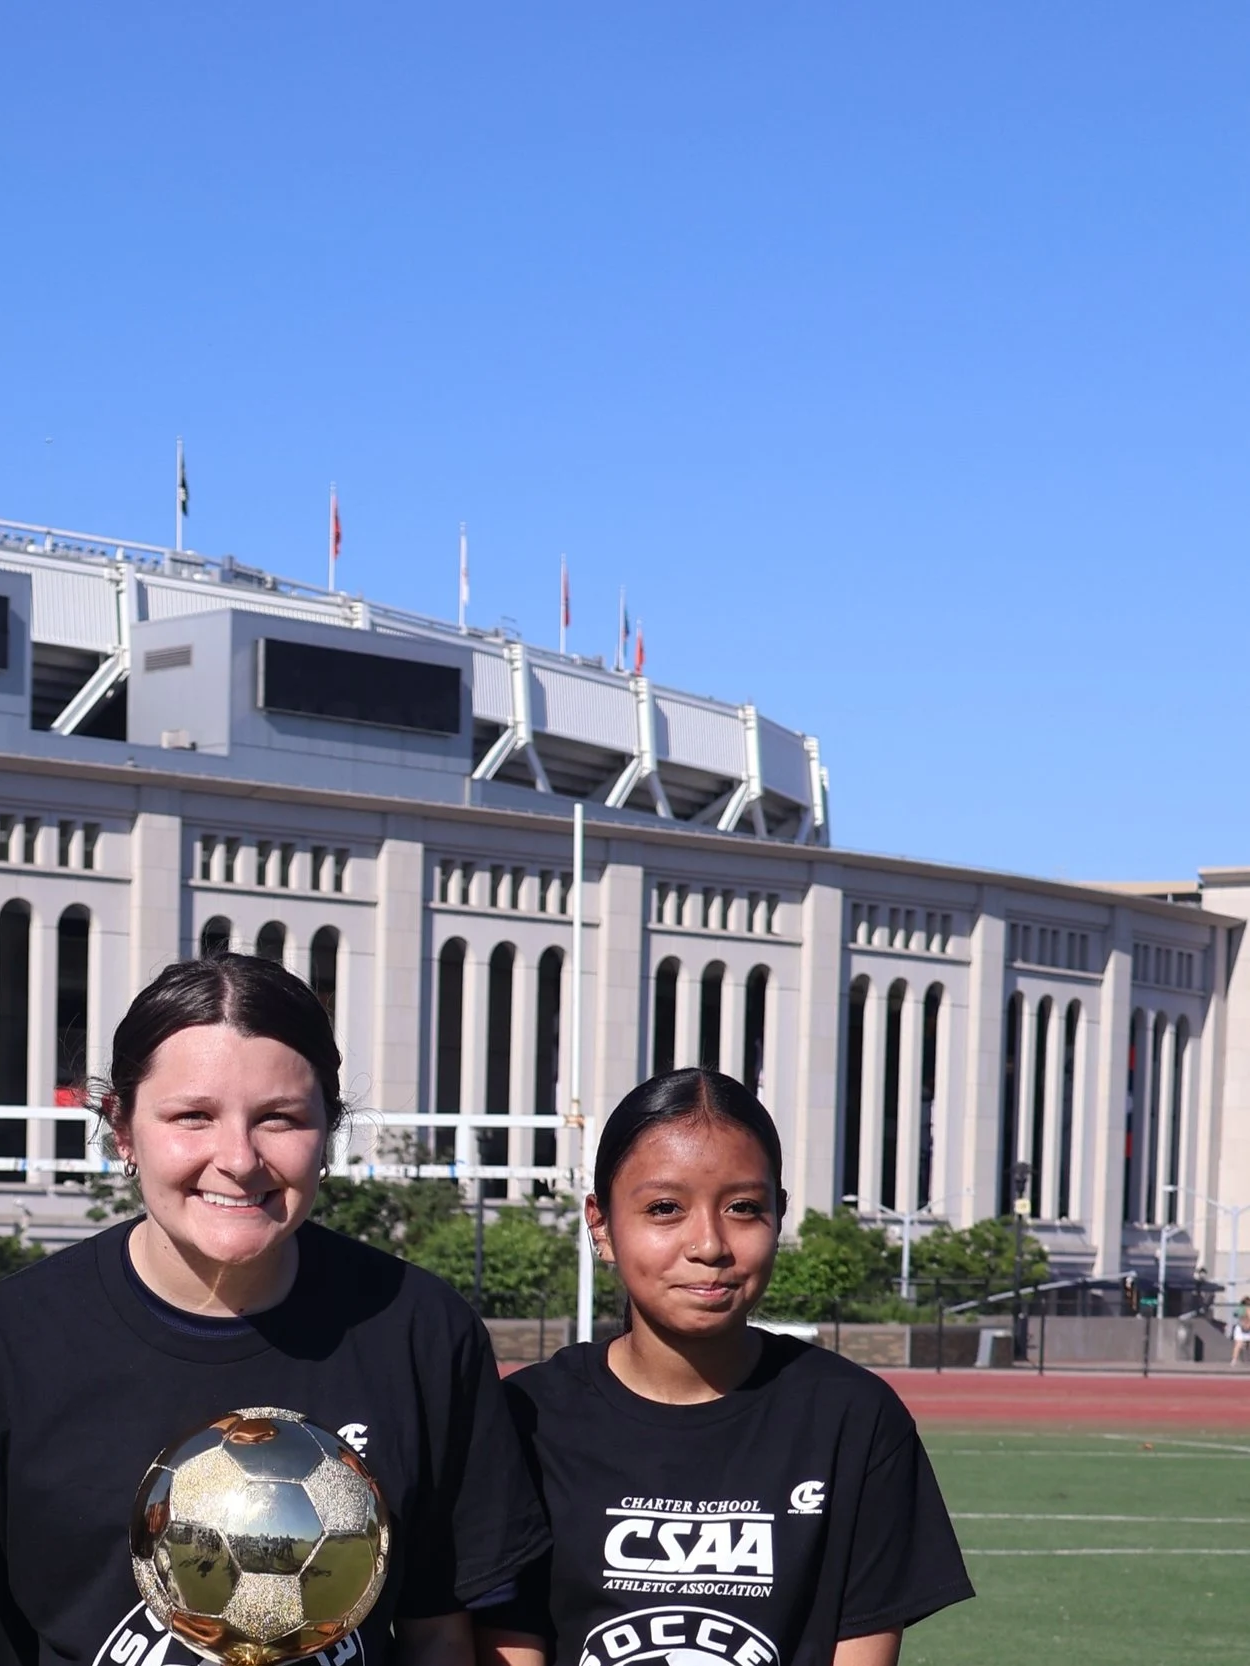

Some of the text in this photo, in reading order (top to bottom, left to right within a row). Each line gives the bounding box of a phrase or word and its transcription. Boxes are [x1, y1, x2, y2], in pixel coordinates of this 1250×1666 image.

[621, 1497, 761, 1513] CHARTER SCHOOL
[604, 1518, 773, 1575] CSAA
[603, 1579, 773, 1598] ATHLETIC ASSOCIATION
